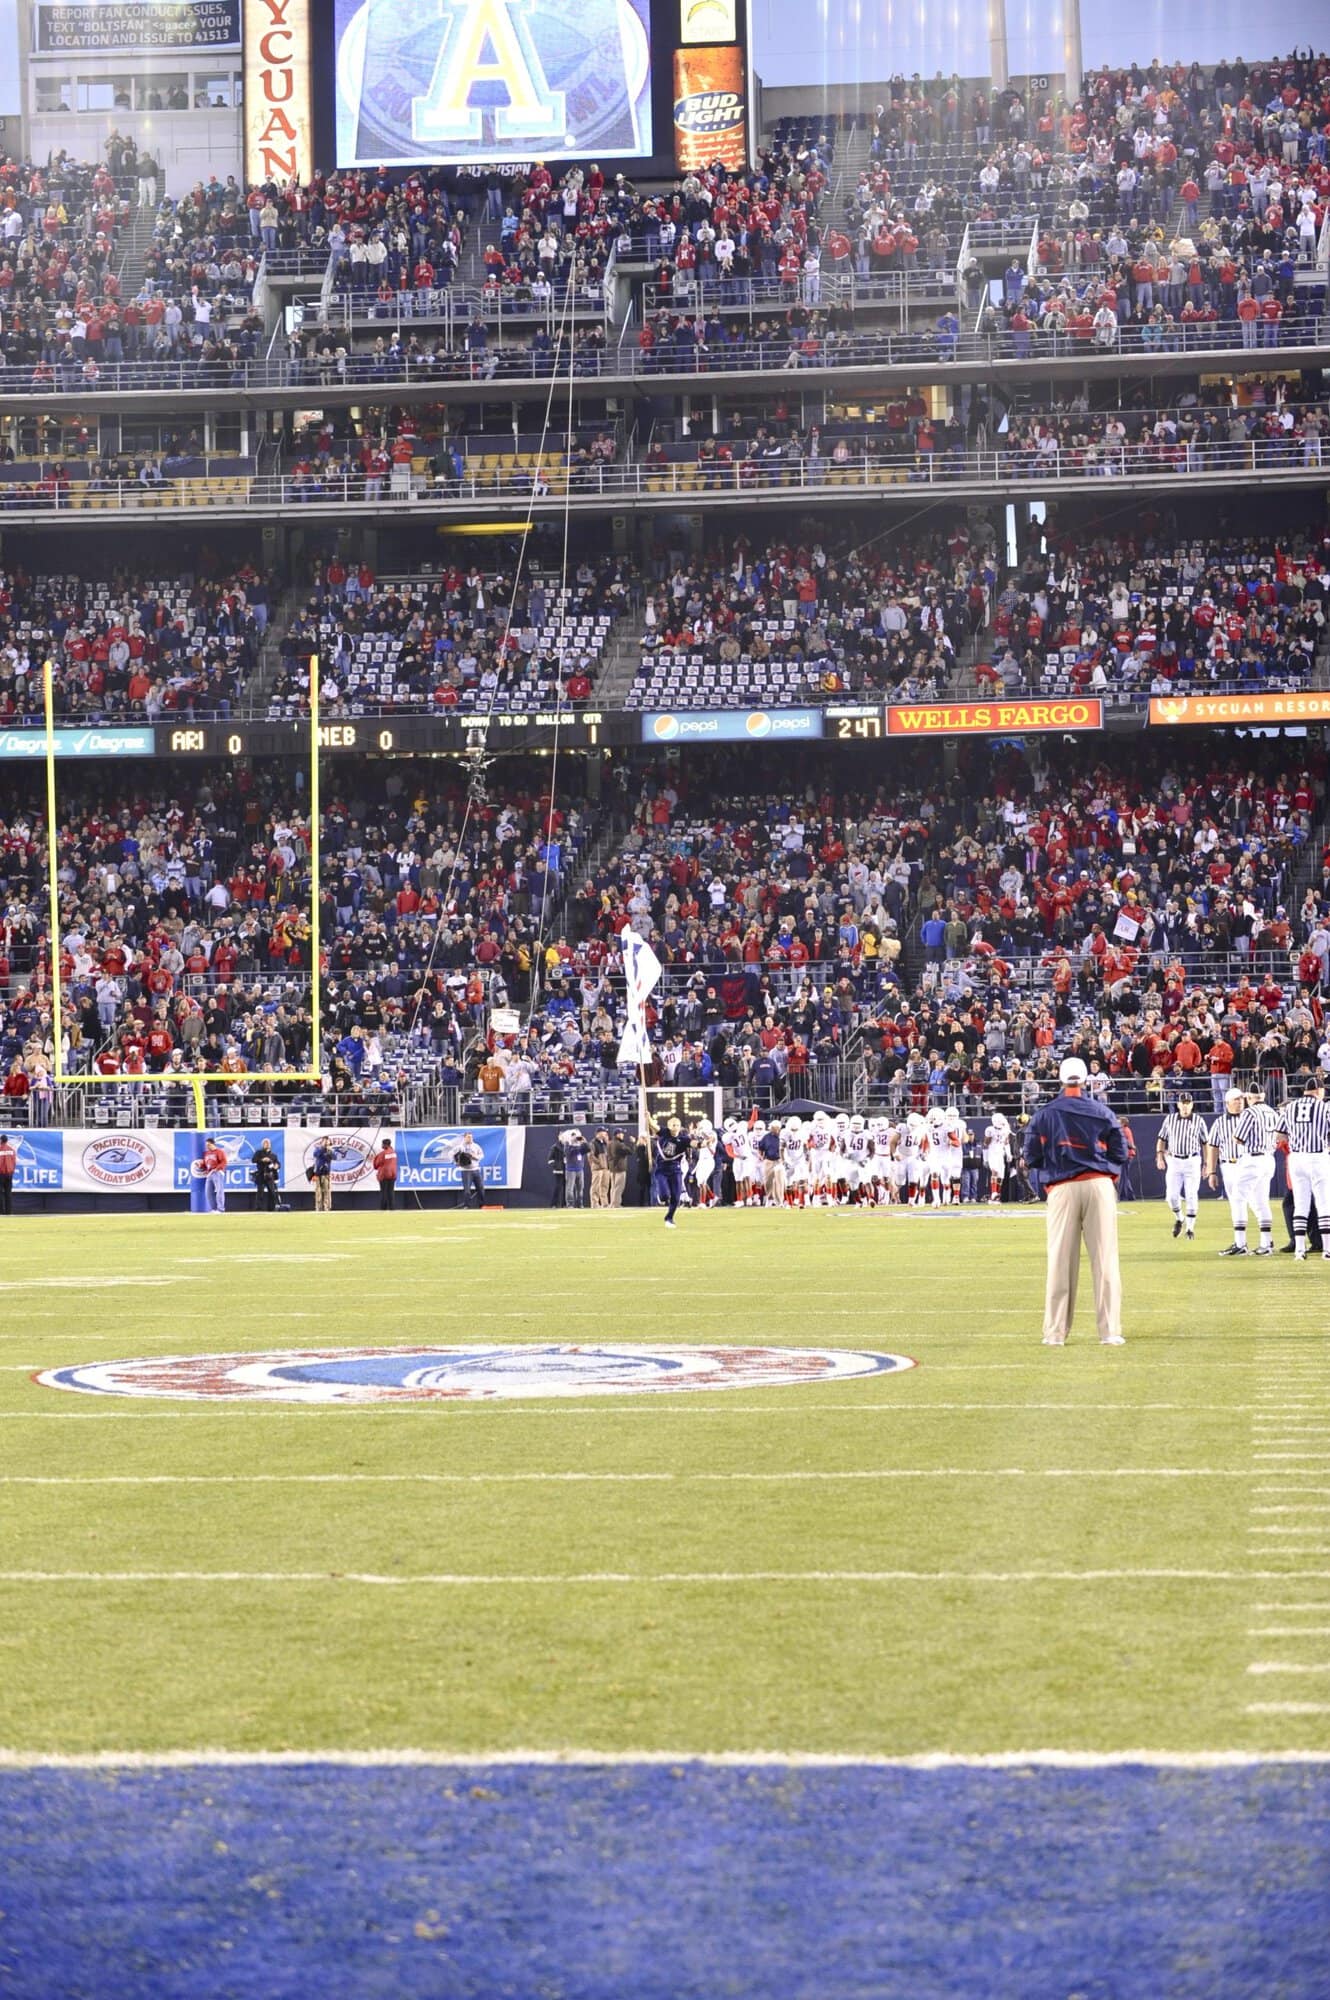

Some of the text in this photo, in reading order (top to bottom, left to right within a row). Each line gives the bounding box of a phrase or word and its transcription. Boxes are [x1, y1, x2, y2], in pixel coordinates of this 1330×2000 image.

[52, 7, 95, 19] REPORT
[99, 6, 123, 18] FAN
[125, 5, 179, 17] CONDUCT
[48, 22, 75, 33] TEXT
[200, 16, 232, 29] YOUR
[50, 29, 229, 46] LOCATION AND ISSUE TO 41513
[1031, 78, 1048, 89] 20
[684, 94, 738, 112] BUD
[678, 105, 745, 125] LIGHT
[461, 717, 490, 727] DOWN
[499, 714, 528, 726] TO GO
[536, 714, 560, 725] BALL
[680, 716, 810, 734] pepsi pepsi
[897, 709, 991, 729] WELLS
[998, 705, 1089, 725] FARGO
[90, 735, 146, 753] Degree
[172, 731, 204, 750] ARI
[228, 735, 241, 755] 0
[318, 726, 356, 746] NEB
[379, 730, 393, 750] 0
[92, 1138, 146, 1154] PACIFIC LIFE
[850, 1138, 864, 1151] 49
[23, 1167, 59, 1184] LIFE
[87, 1164, 150, 1184] HOLIDAY BOWL
[400, 1165, 503, 1183] PACIFIC FE
